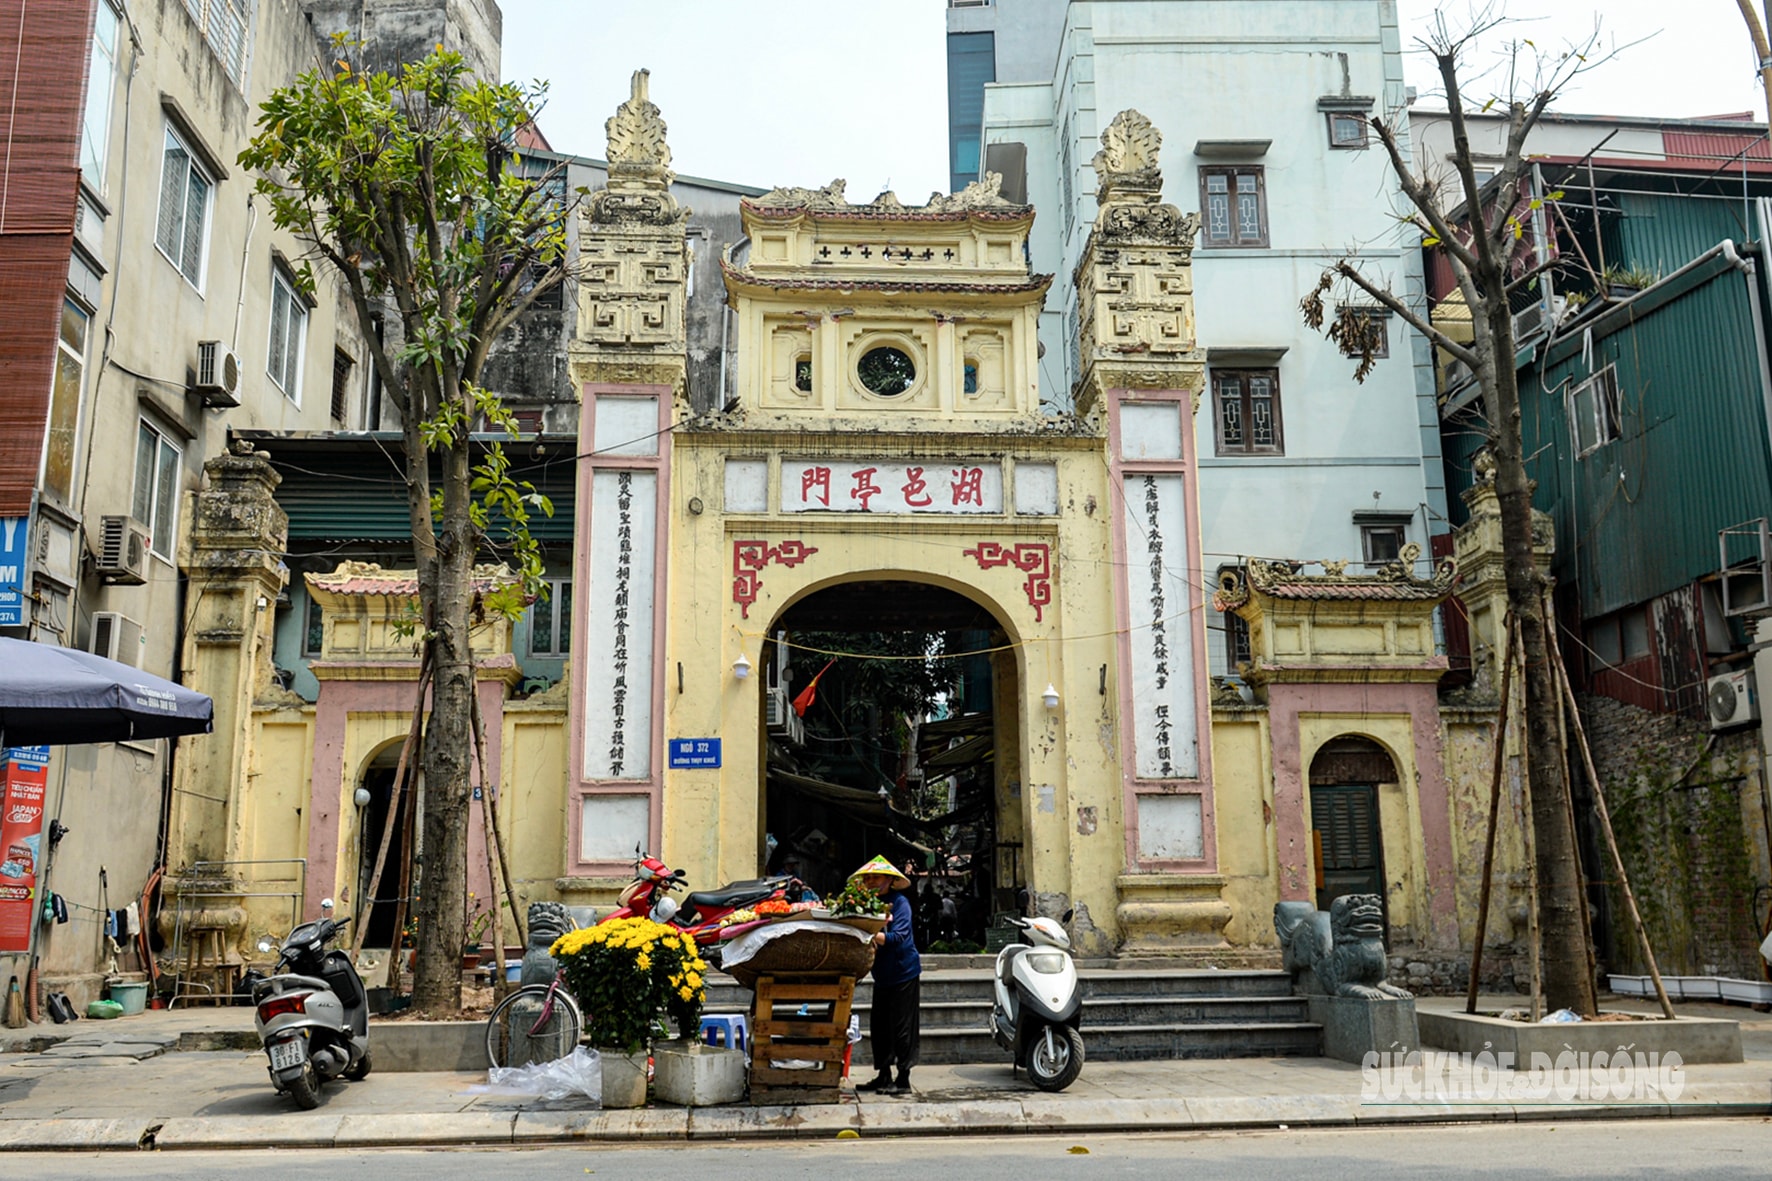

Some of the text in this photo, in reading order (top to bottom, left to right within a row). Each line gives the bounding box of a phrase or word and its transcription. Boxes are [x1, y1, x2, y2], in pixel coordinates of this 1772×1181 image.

[697, 743, 709, 752] 372
[12, 804, 38, 814] JAPAN
[276, 1053, 301, 1069] 8126
